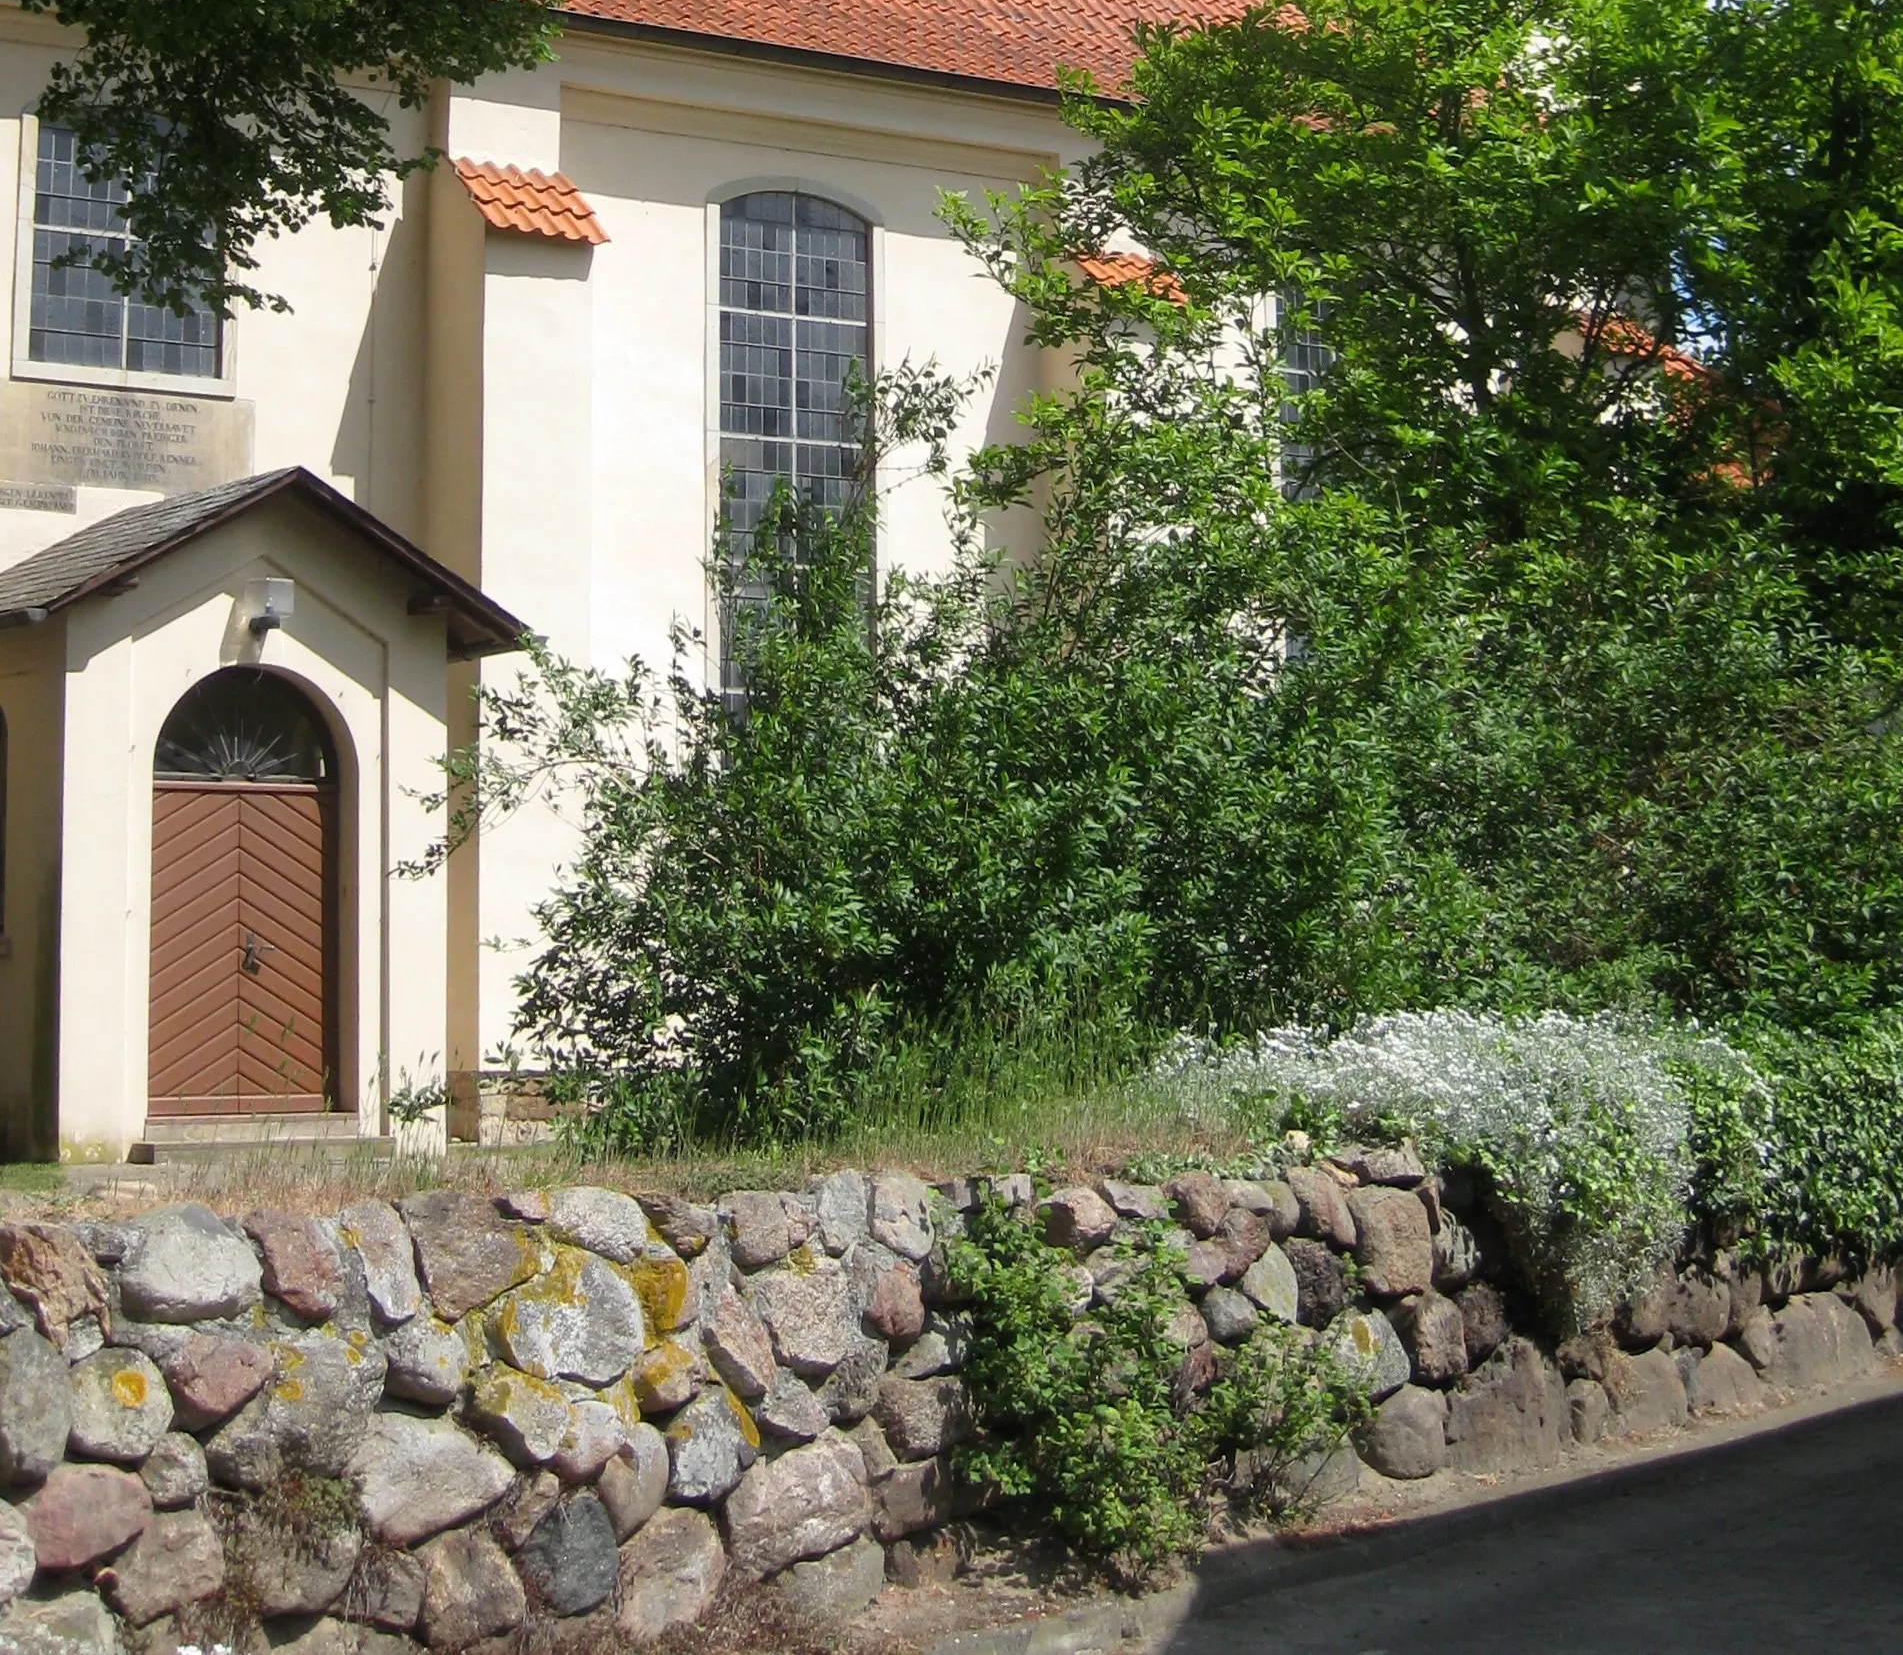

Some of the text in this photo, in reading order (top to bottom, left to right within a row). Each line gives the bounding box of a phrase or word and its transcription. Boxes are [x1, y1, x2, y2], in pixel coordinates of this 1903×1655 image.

[47, 390, 75, 402] GOTT
[40, 411, 61, 422] VON
[66, 414, 84, 424] DER
